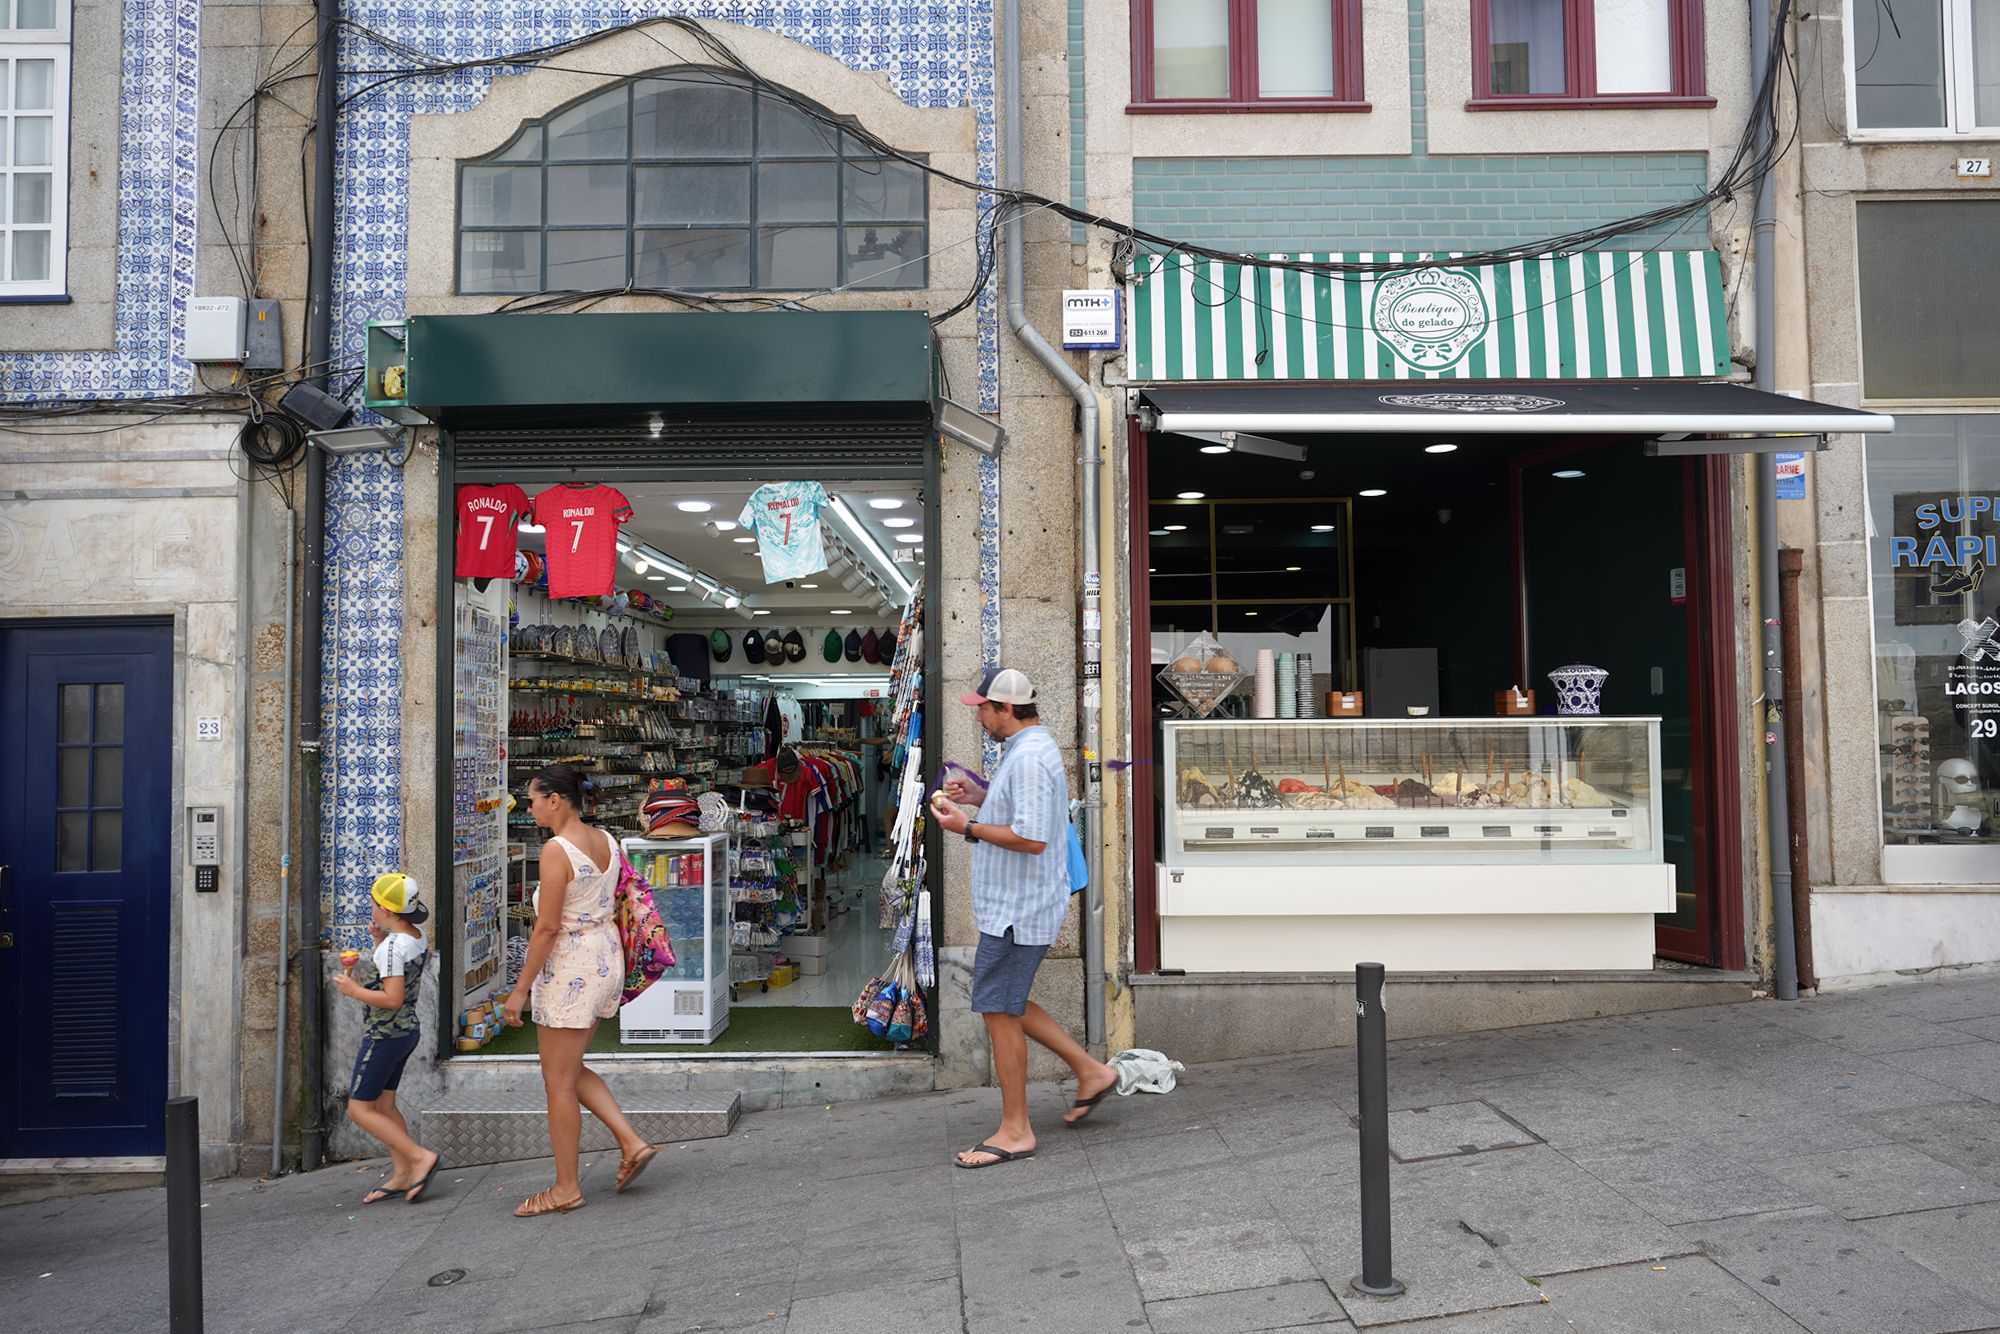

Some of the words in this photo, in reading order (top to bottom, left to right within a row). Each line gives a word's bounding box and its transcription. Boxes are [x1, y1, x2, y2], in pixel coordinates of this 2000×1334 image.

[1966, 161, 1982, 173] 27
[1397, 303, 1458, 317] Boutique
[1402, 318, 1415, 327] do
[1418, 318, 1454, 328] gelado
[467, 497, 508, 514] RONALDO
[767, 497, 800, 511] RONALDO
[562, 506, 595, 519] RONALDO
[476, 515, 495, 551] 7
[570, 520, 584, 553] 7
[779, 513, 792, 546] 7
[199, 722, 219, 735] 23
[1970, 719, 1997, 738] 29
